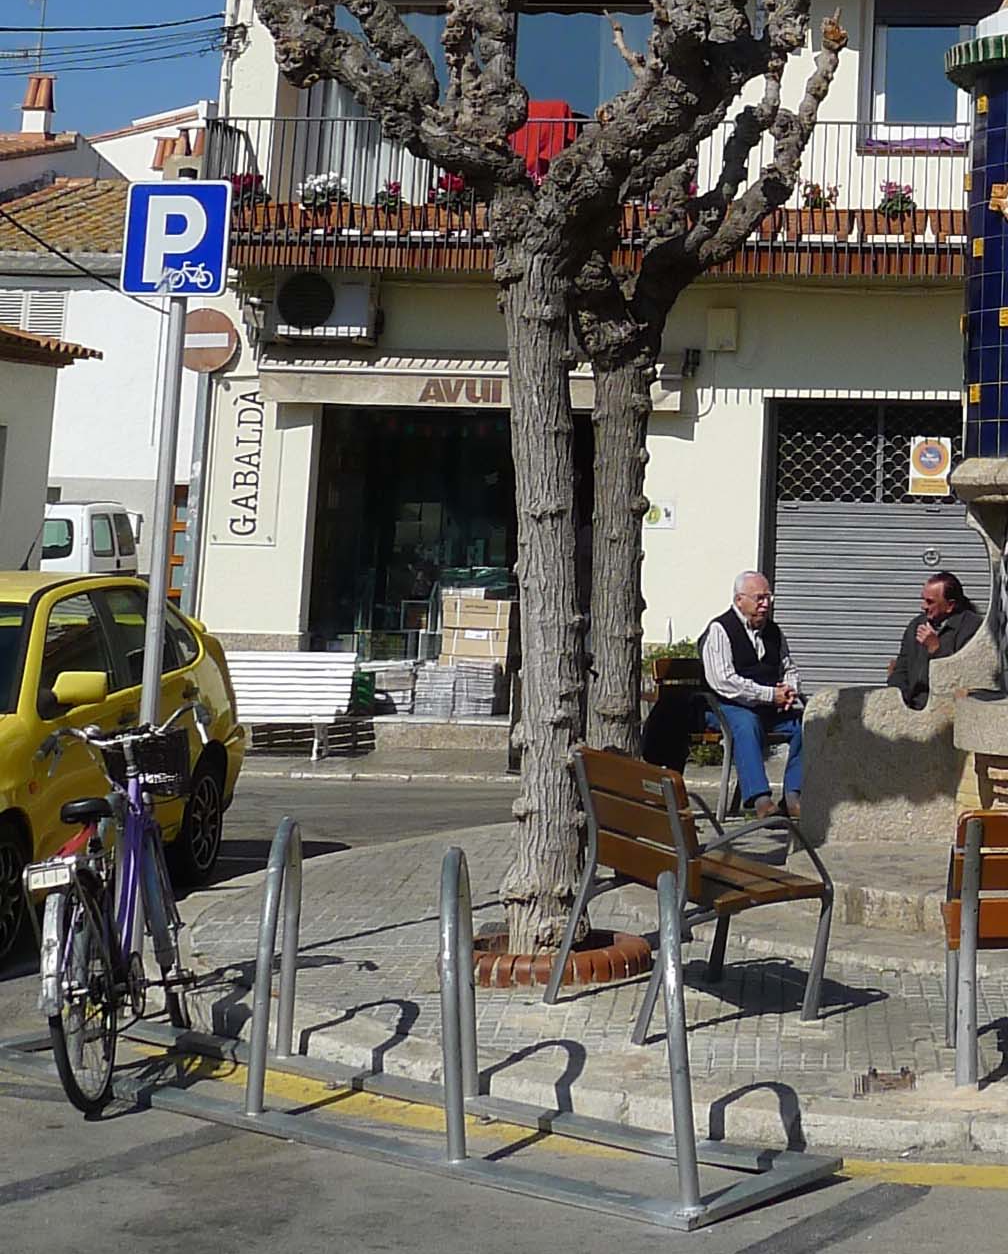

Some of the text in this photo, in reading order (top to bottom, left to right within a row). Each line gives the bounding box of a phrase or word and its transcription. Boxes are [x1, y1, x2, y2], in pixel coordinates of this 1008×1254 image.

[142, 195, 207, 283] P
[418, 378, 503, 403] AVUI
[229, 391, 264, 536] GABALDÀ
